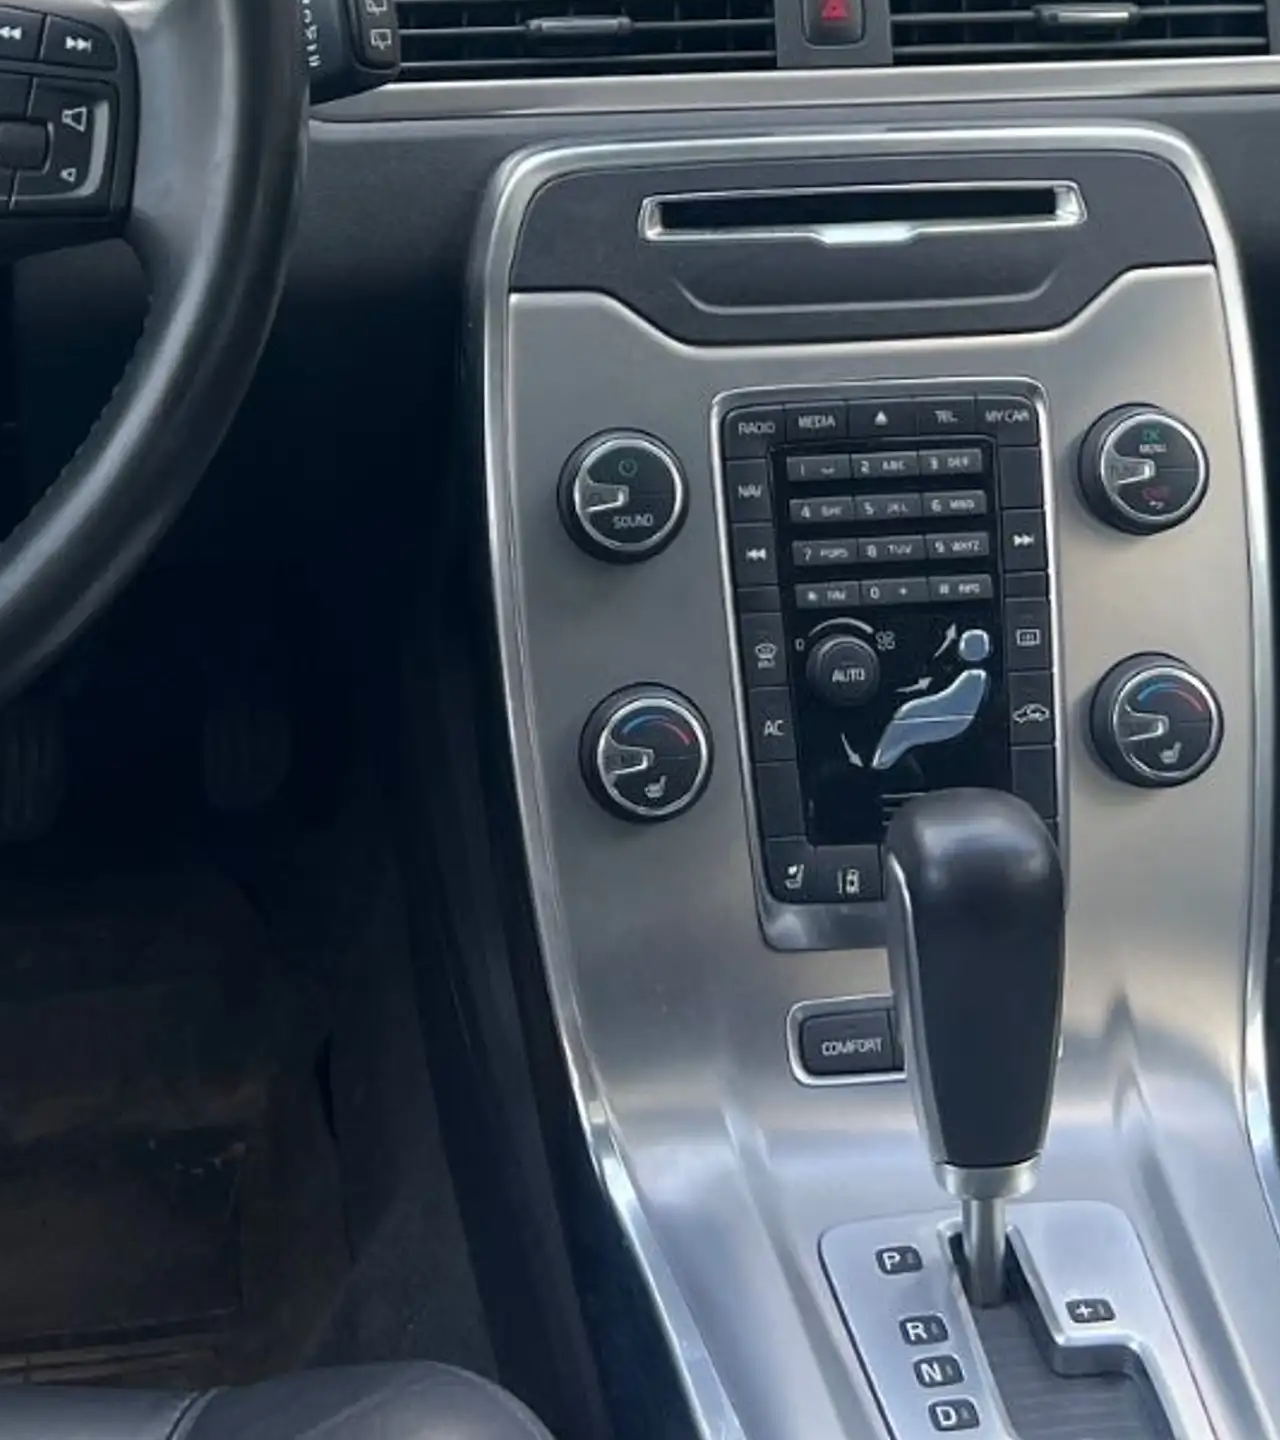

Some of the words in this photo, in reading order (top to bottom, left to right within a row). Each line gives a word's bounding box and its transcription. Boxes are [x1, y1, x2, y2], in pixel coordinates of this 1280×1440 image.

[738, 421, 776, 435] RADIO
[798, 415, 836, 429] MEDIA
[738, 484, 763, 499] NAV
[931, 498, 942, 512] 6
[613, 513, 654, 530] SOUND
[831, 667, 865, 683] AUTO
[764, 720, 785, 736] AC
[821, 1037, 884, 1057] COMFORT
[881, 1250, 902, 1271] P
[905, 1321, 929, 1341] R
[921, 1363, 942, 1383] N
[936, 1405, 957, 1427] D
